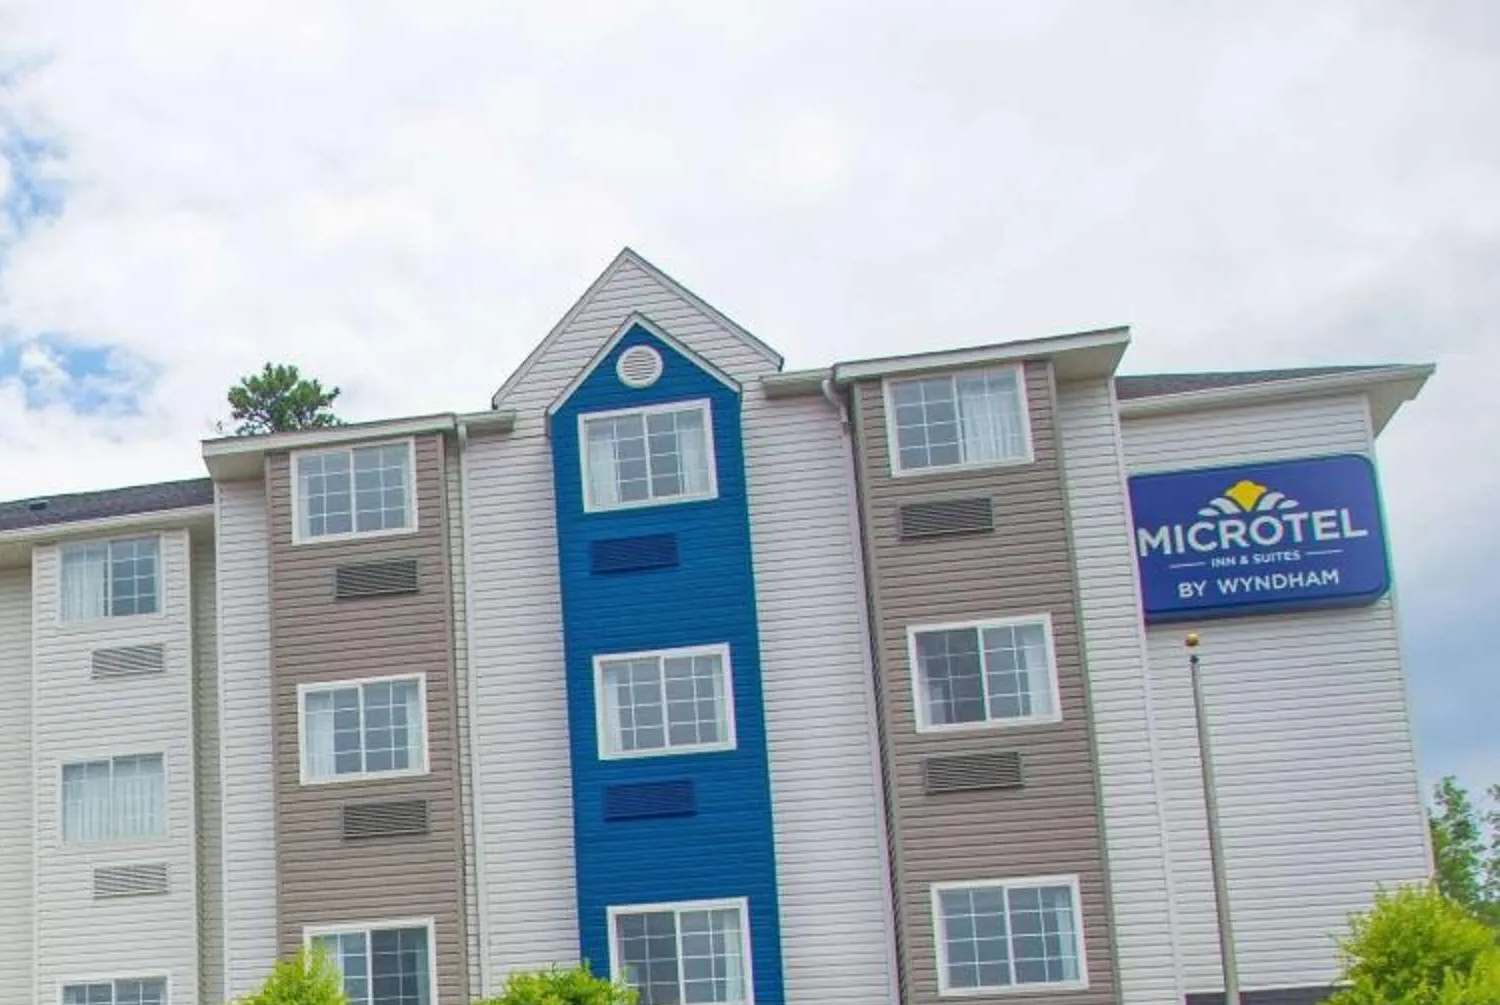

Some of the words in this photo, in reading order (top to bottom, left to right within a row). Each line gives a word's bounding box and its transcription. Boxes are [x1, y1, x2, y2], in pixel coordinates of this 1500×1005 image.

[1137, 508, 1368, 557] MICROTEL
[1211, 557, 1236, 568] INN
[1239, 555, 1250, 565] &
[1252, 551, 1301, 565] SUITES
[1178, 580, 1207, 598] BY
[1216, 569, 1340, 595] WYNDHAM
